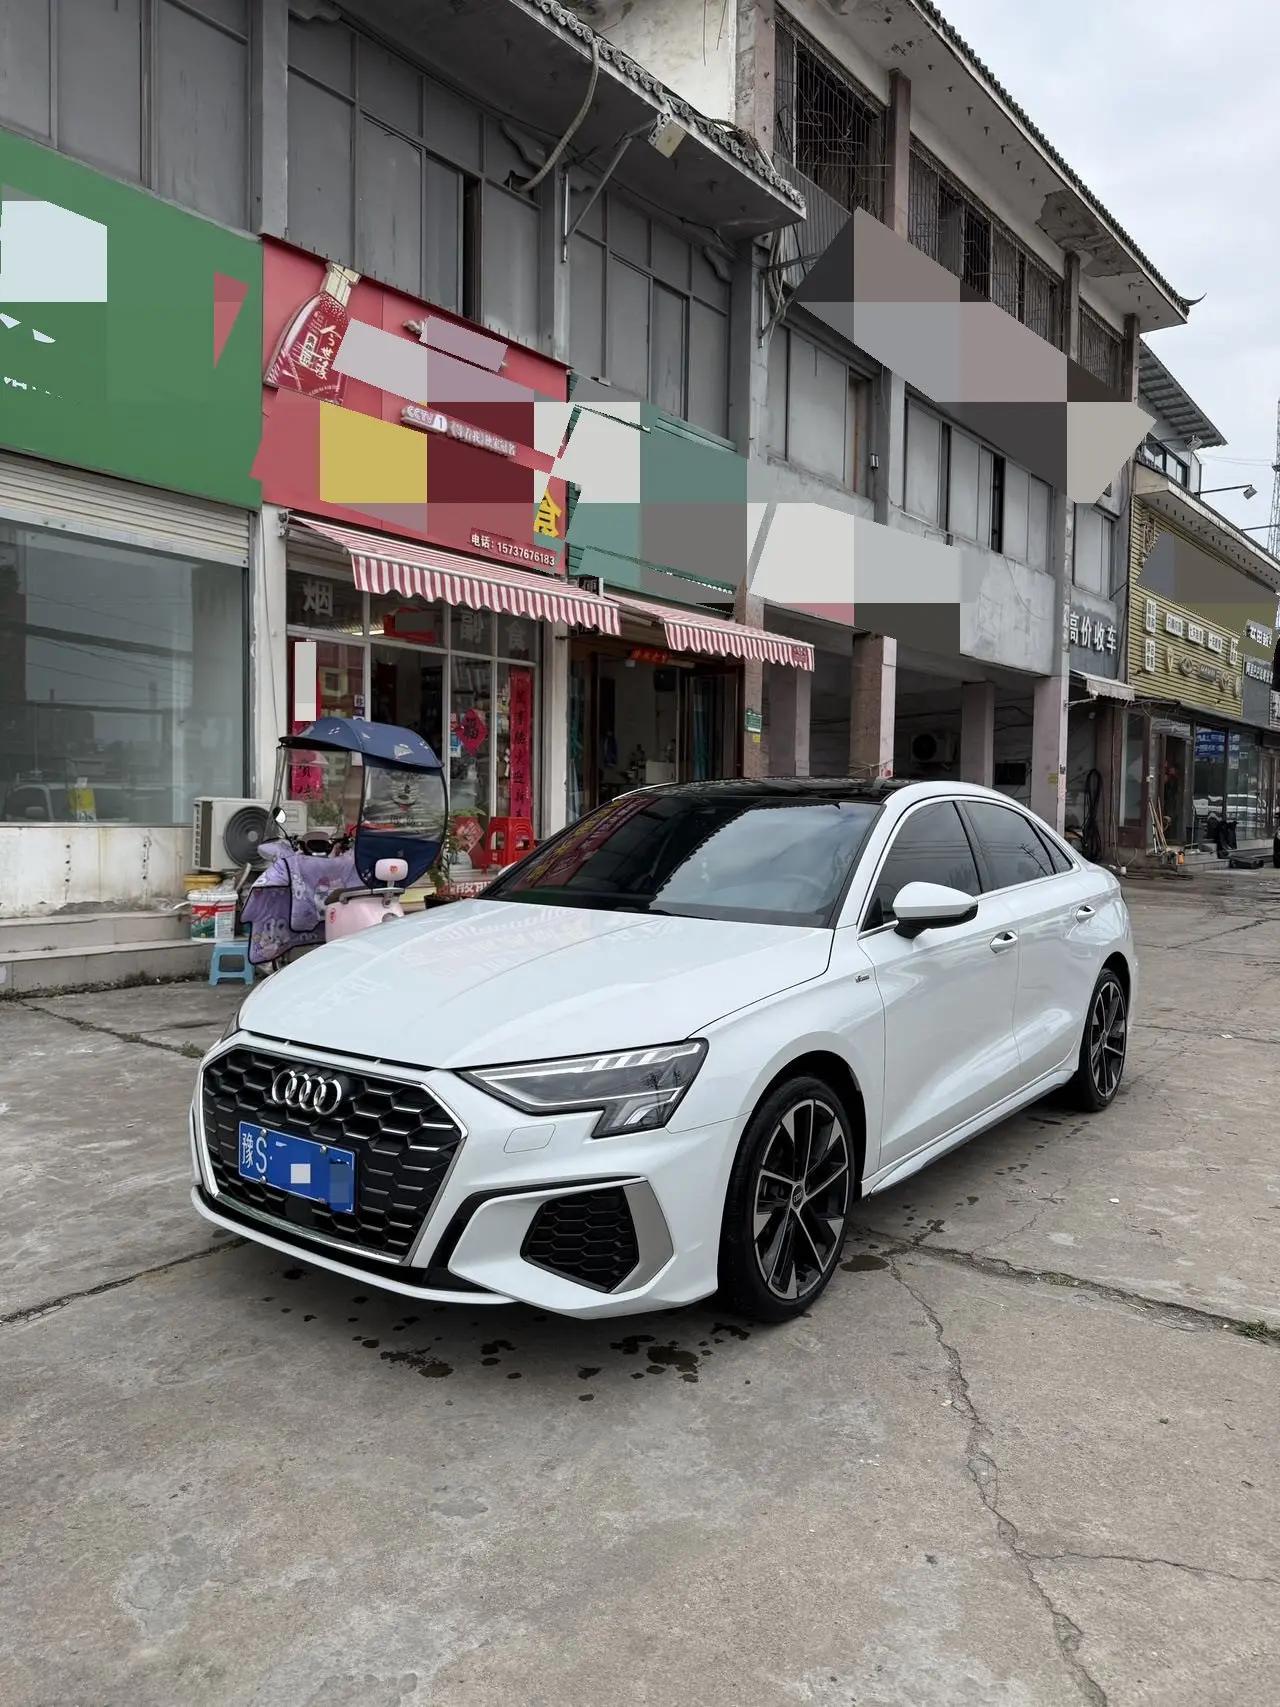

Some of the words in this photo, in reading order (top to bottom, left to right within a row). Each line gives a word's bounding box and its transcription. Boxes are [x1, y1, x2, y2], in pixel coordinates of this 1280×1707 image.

[303, 577, 333, 617] 烟
[1069, 611, 1117, 655] 高价收车
